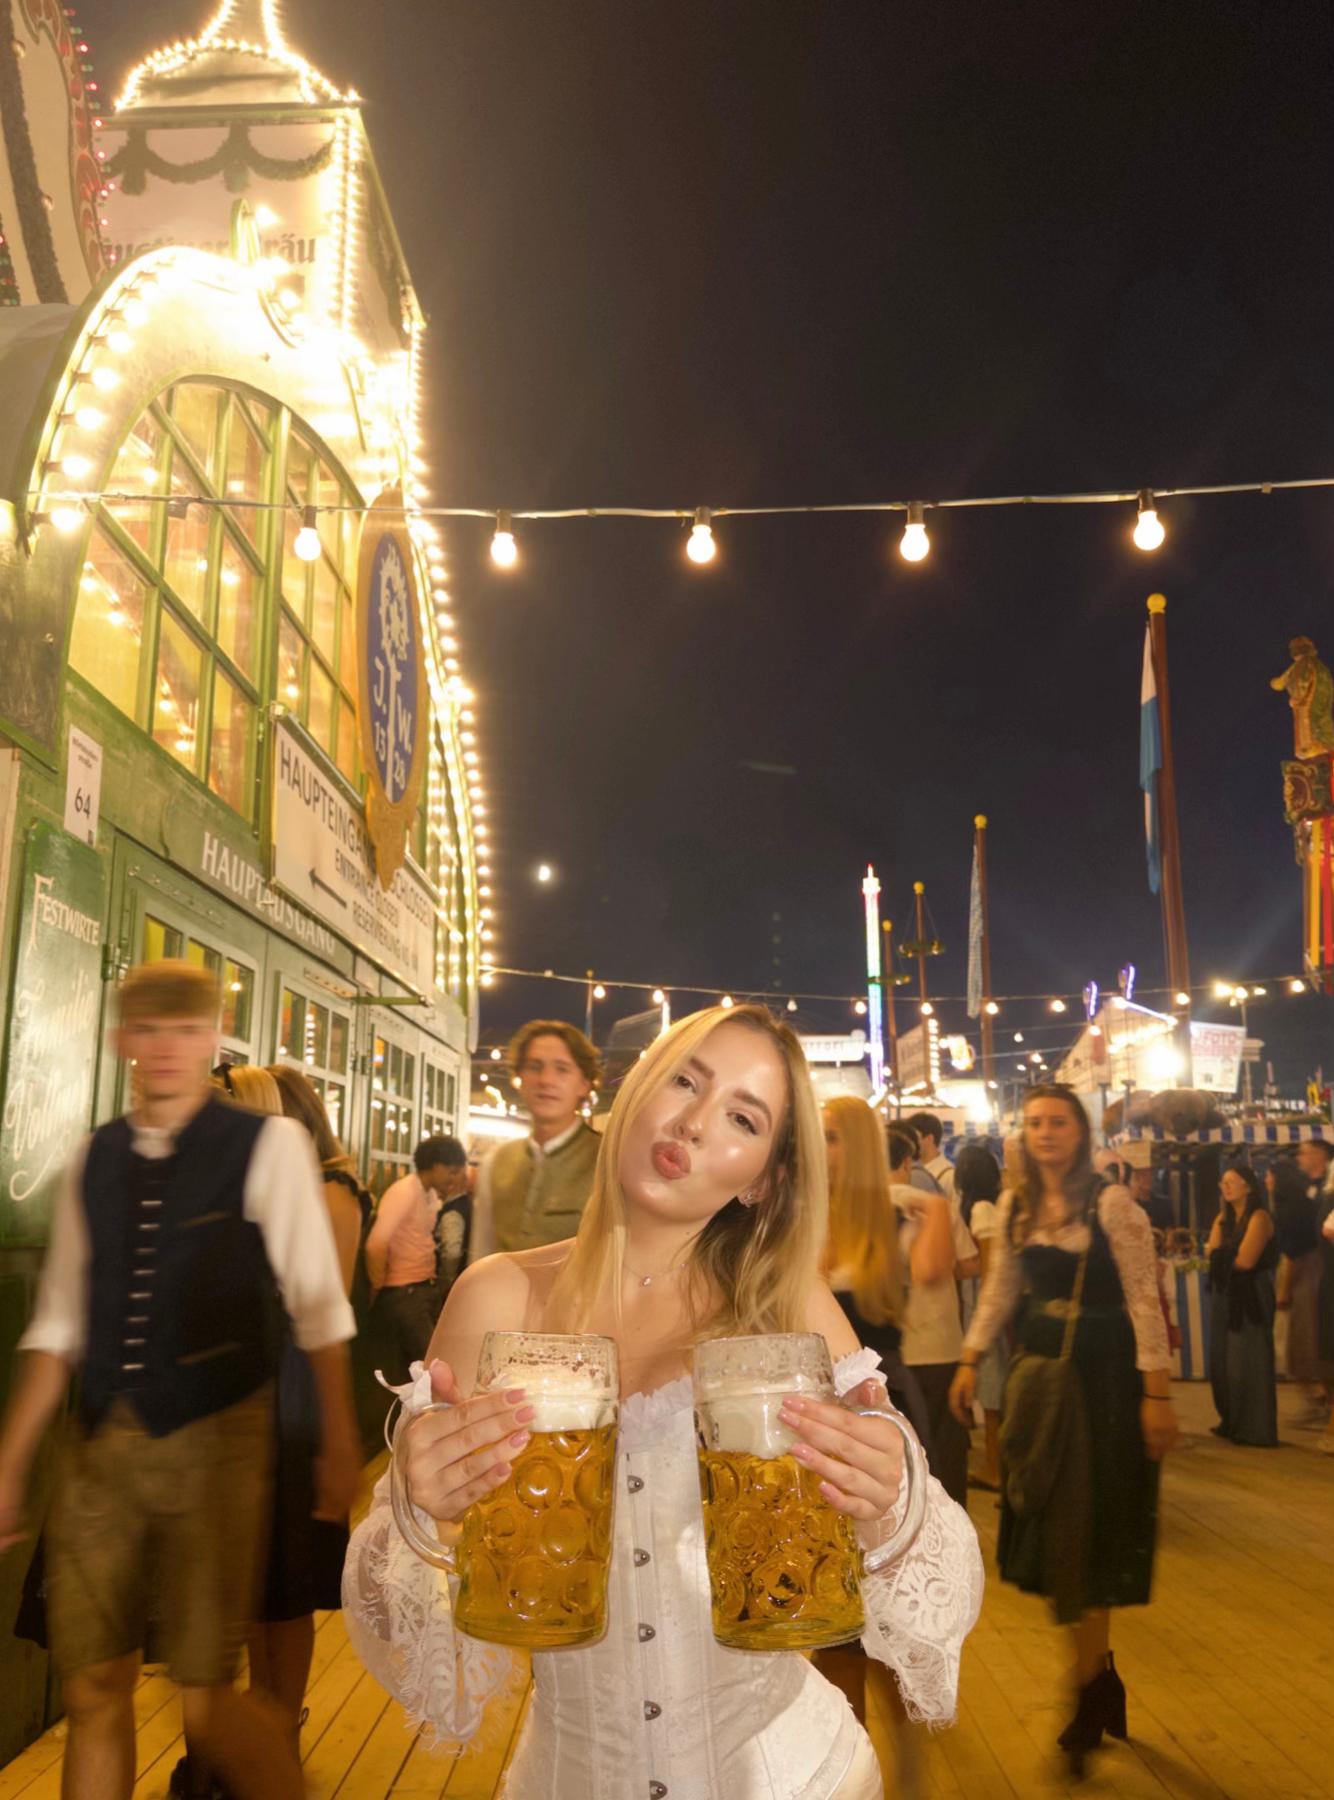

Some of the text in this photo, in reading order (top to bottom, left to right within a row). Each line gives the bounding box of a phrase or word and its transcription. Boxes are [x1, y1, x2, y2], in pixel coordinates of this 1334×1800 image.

[374, 721, 406, 791] 13 28
[74, 786, 91, 820] 64
[28, 872, 100, 951] FESTWIRTE
